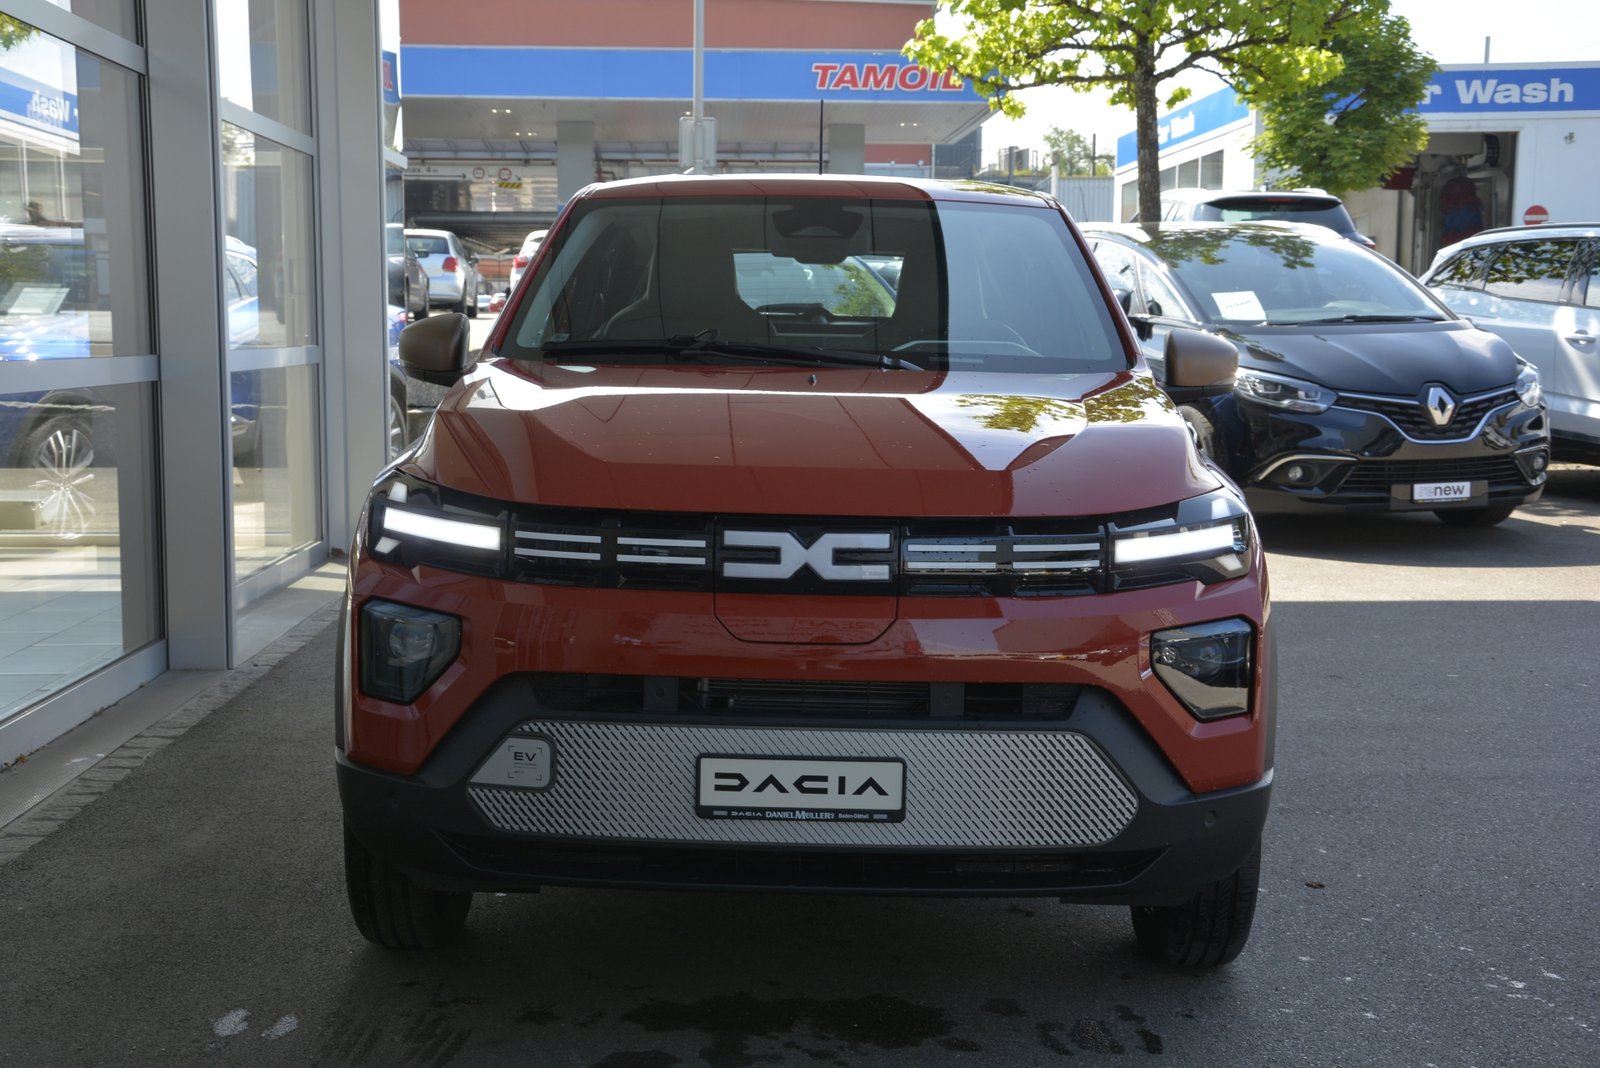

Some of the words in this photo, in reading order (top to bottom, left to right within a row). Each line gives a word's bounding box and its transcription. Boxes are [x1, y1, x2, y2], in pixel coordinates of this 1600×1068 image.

[812, 63, 965, 91] TAMOIL
[1455, 78, 1575, 105] Wash
[514, 751, 537, 762] EV
[714, 772, 889, 797] DACIA
